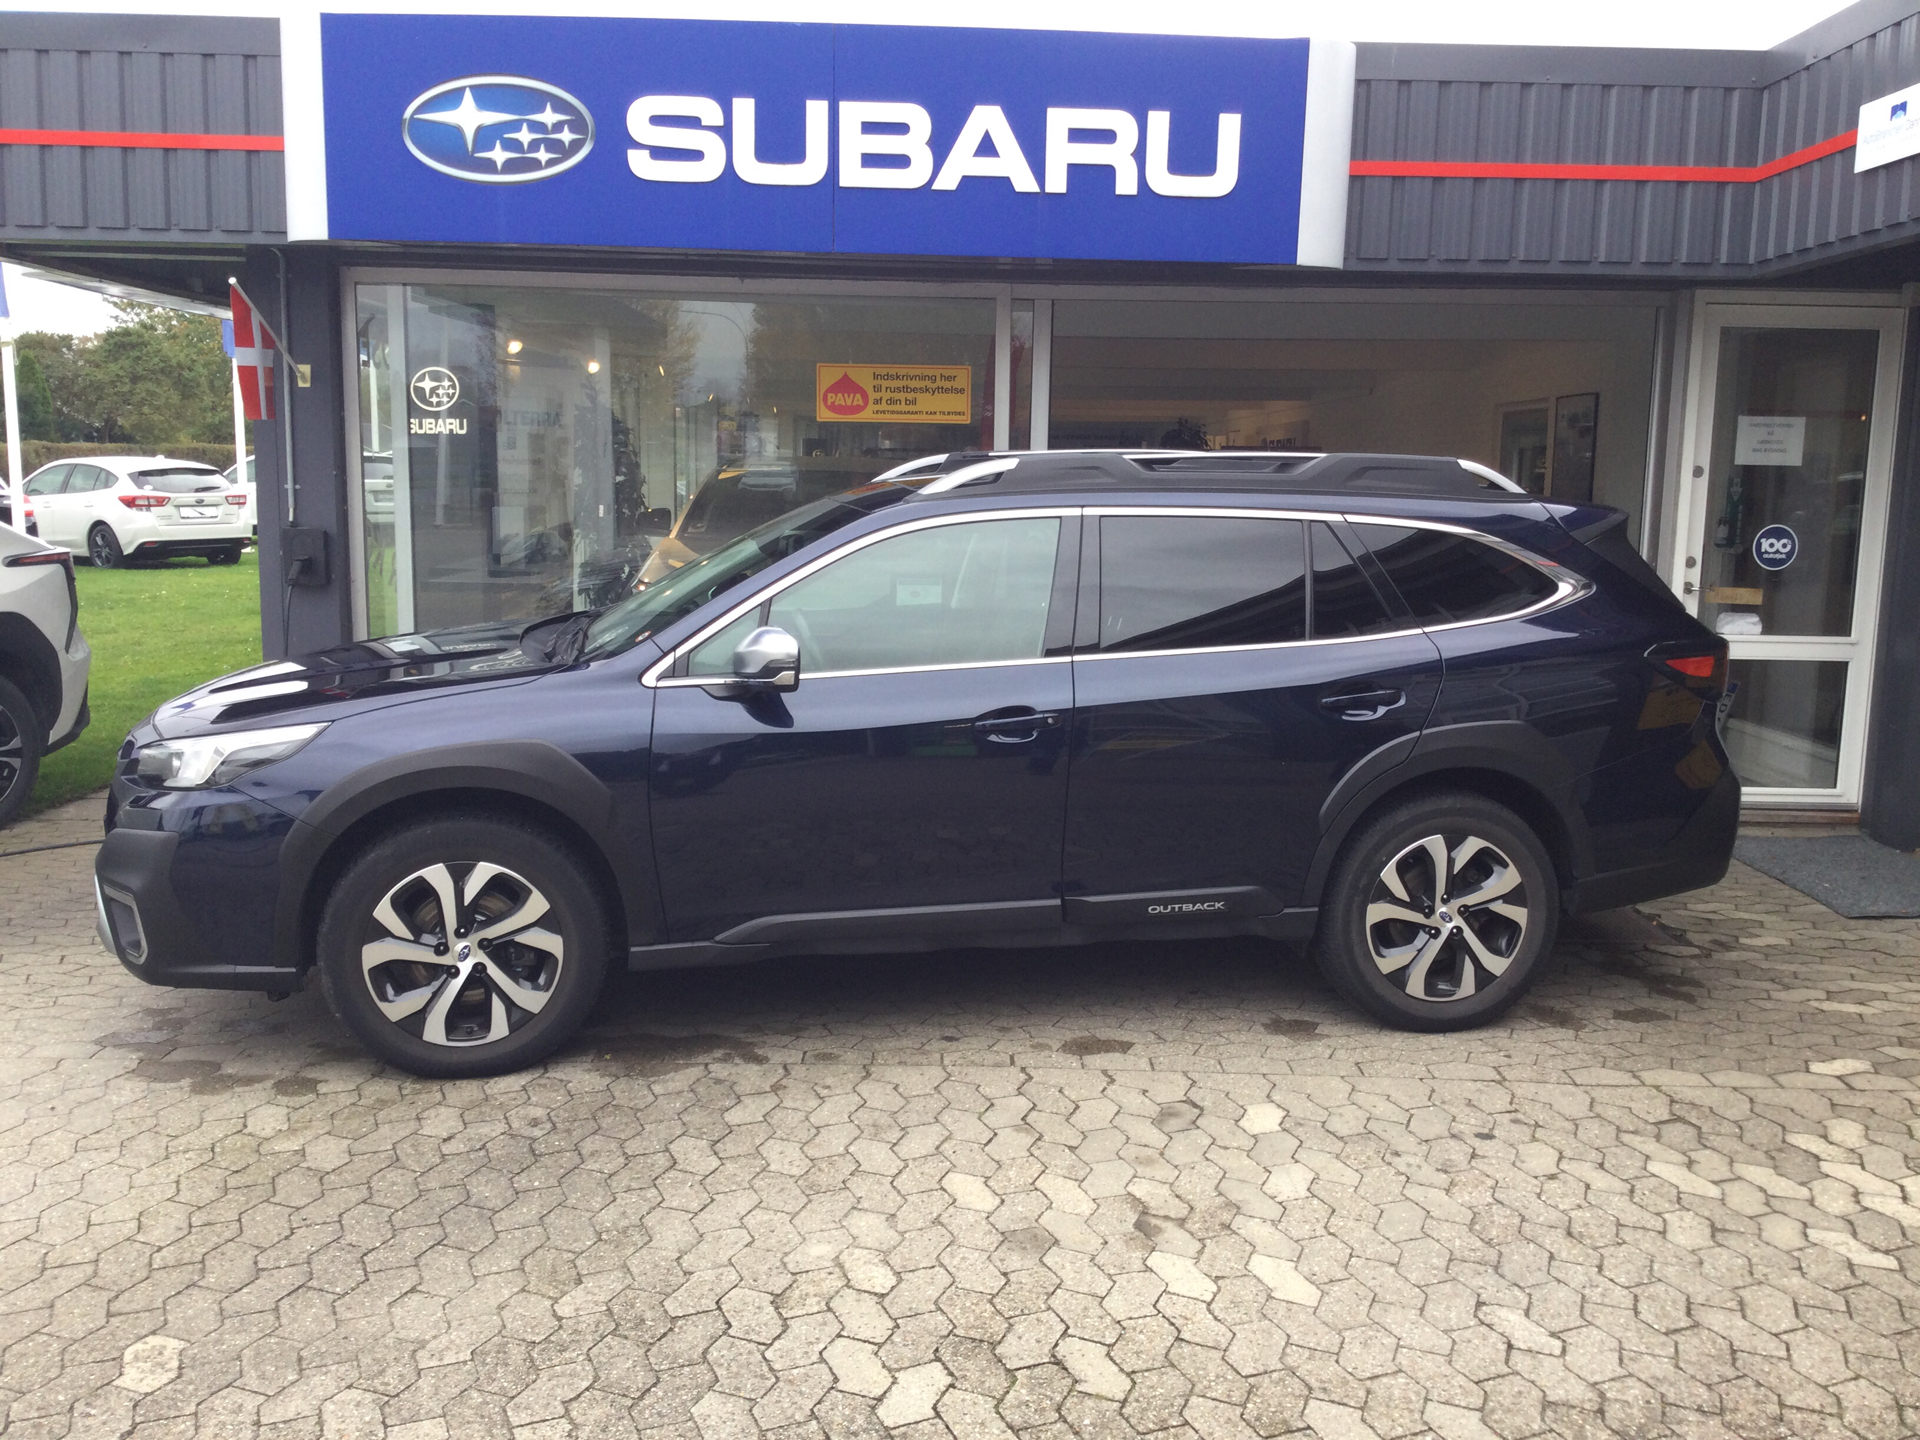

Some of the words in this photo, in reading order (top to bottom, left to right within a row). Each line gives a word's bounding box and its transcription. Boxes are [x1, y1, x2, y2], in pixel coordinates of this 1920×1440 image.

[626, 95, 1241, 198] SUBARU
[872, 371, 937, 384] Indskrivning
[940, 373, 957, 382] her
[872, 384, 882, 393] til
[885, 384, 966, 396] rustbeskyttelse
[827, 392, 864, 407] PAVA
[872, 397, 883, 406] af
[886, 397, 902, 406] din
[904, 397, 917, 406] bil
[410, 418, 467, 435] SUBARU
[1147, 901, 1225, 914] OUTBACK
